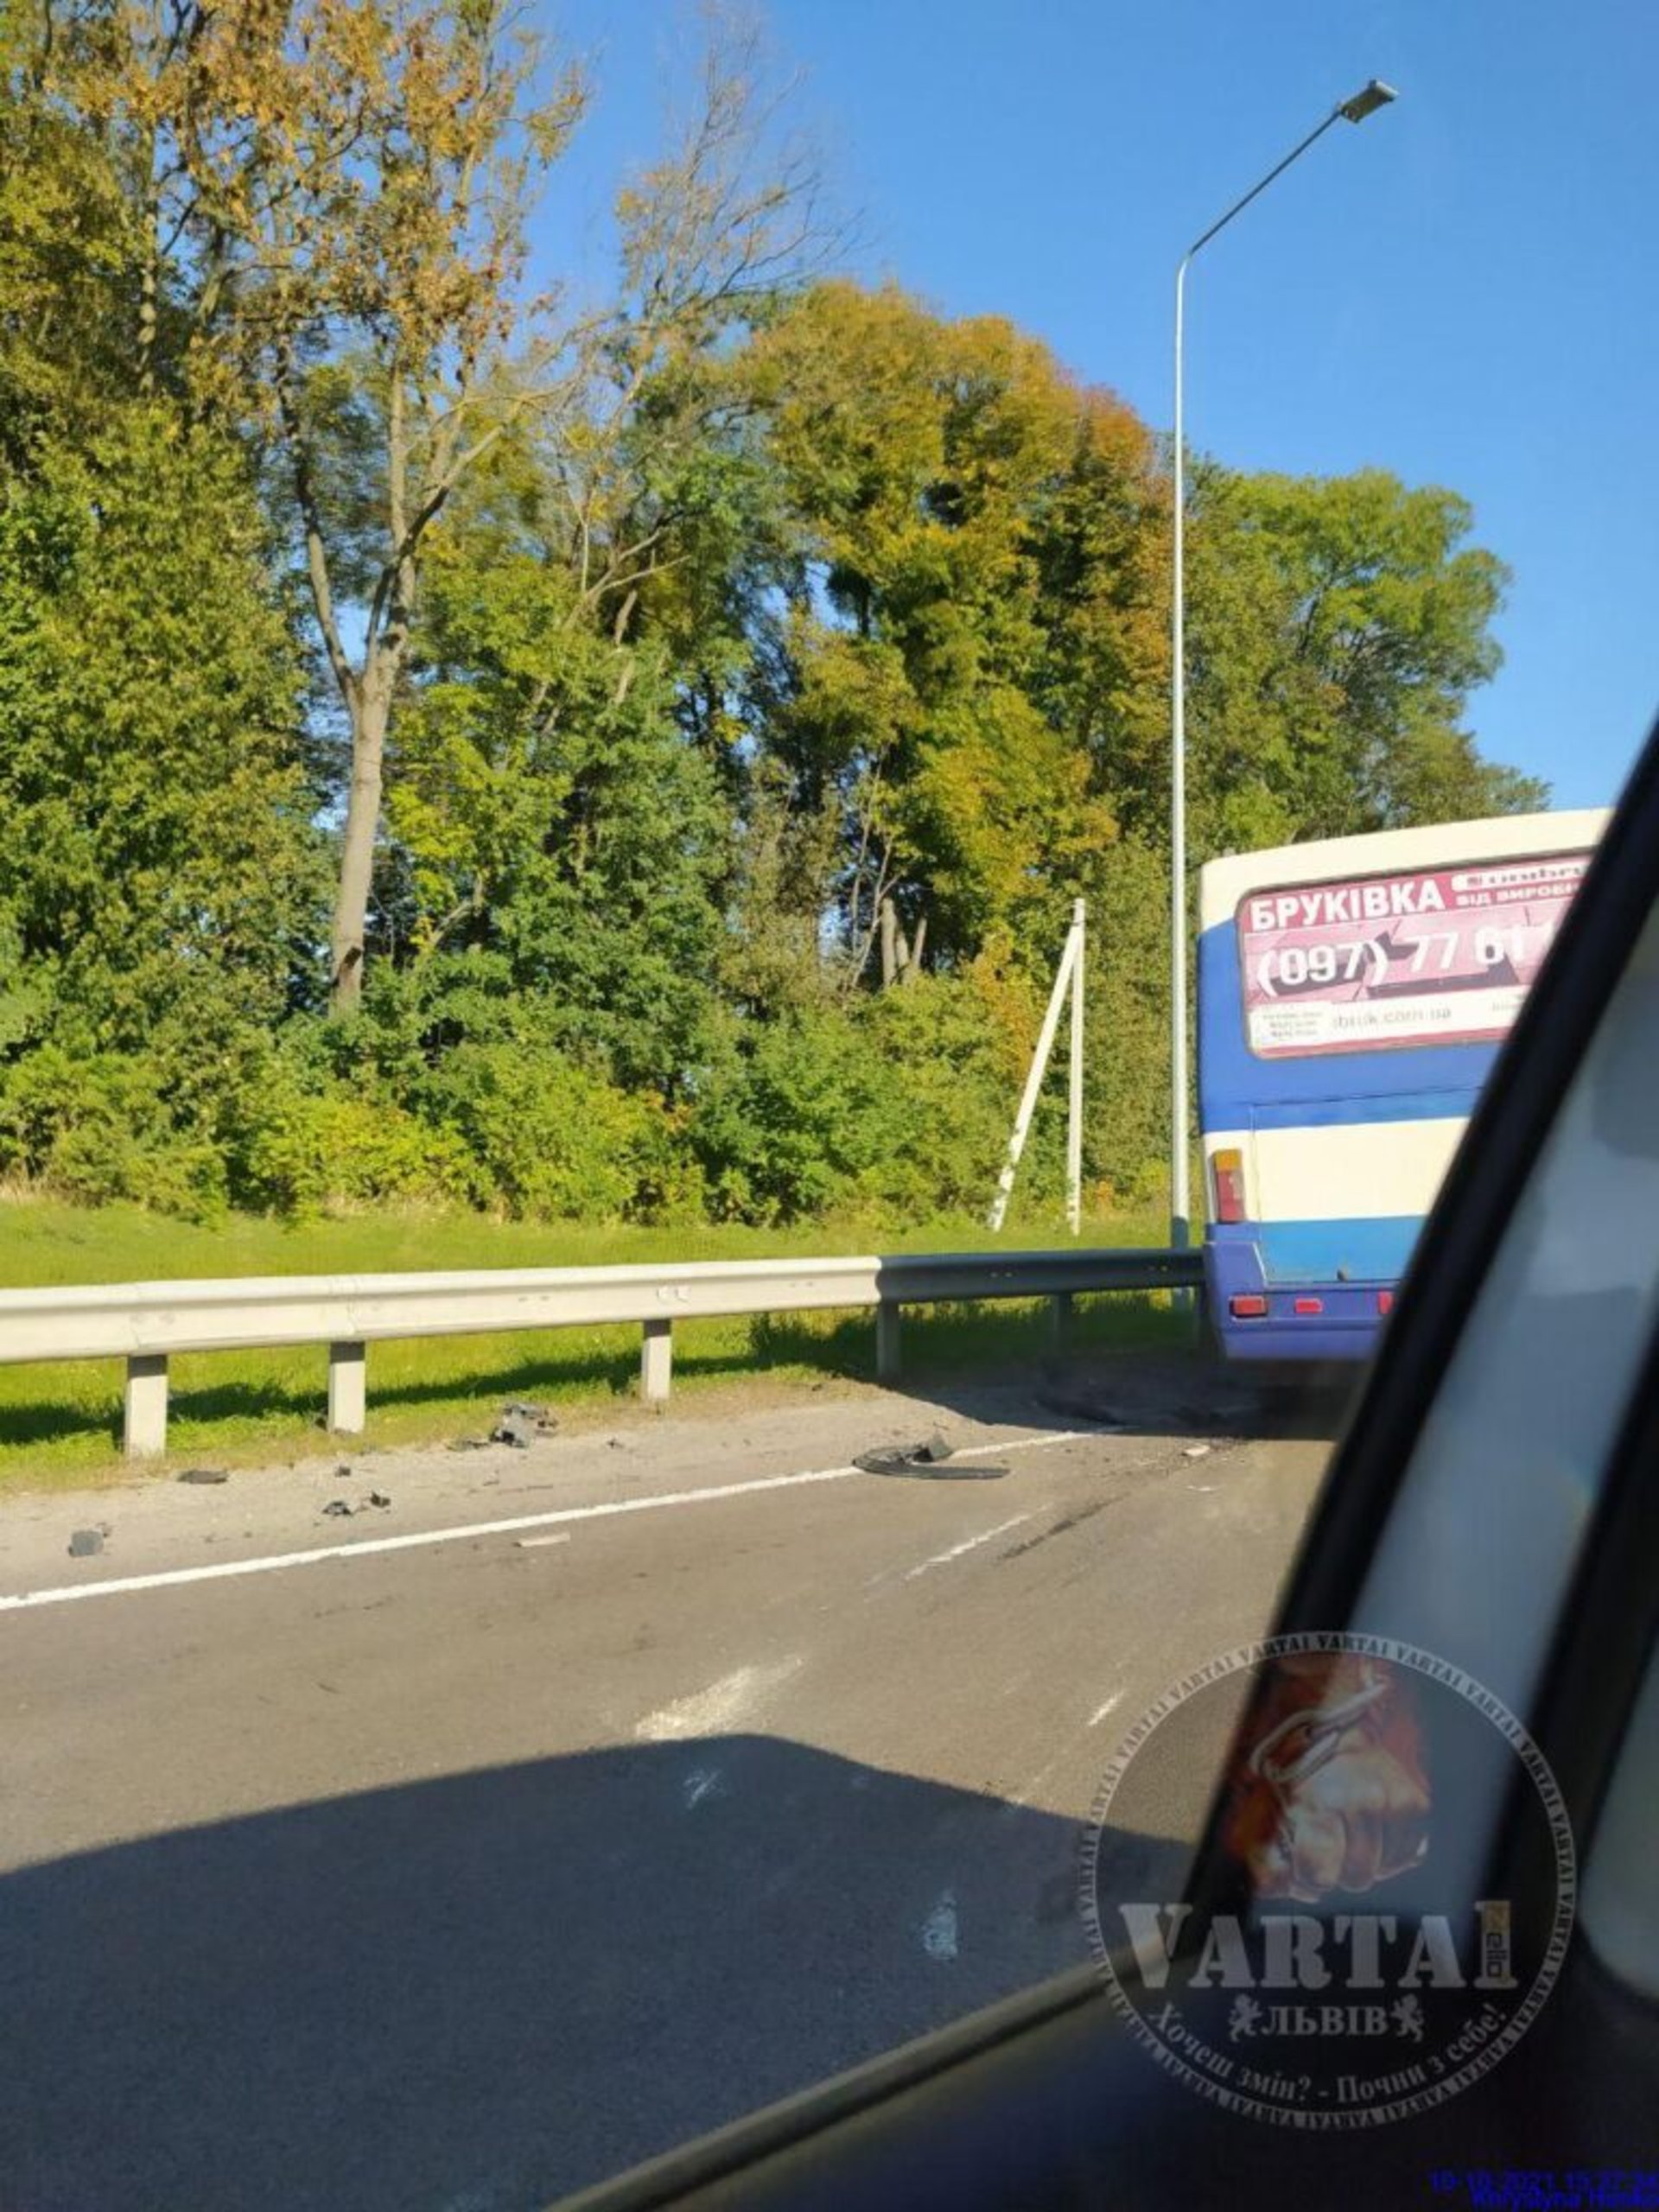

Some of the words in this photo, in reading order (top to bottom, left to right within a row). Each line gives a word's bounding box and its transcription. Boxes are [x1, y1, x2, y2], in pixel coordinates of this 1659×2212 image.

[1249, 879, 1446, 931] БРУКІВКА
[1258, 938, 1389, 997] (097)
[1406, 931, 1459, 974] 77
